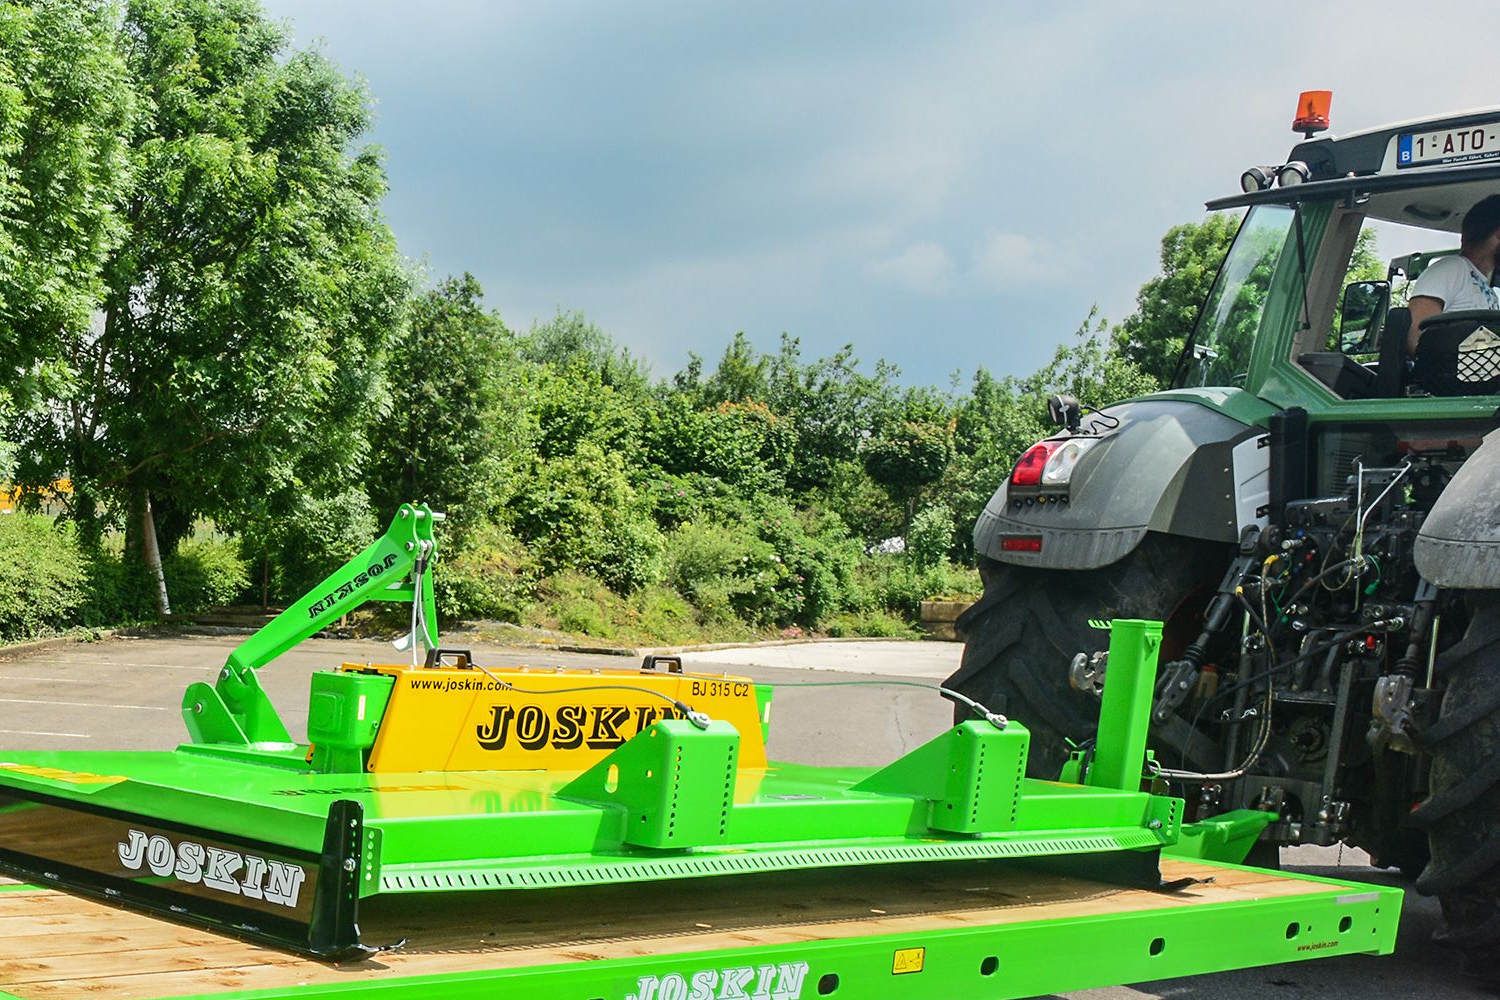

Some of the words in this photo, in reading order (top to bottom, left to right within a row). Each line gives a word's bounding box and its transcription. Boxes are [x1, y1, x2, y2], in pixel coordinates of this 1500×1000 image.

[1402, 151, 1410, 161] B
[308, 553, 398, 618] JOSKIN
[411, 678, 513, 692] www.joskin.com
[692, 682, 708, 696] BJ
[710, 682, 730, 697] 315
[733, 683, 749, 697] C2
[117, 829, 306, 908] JOSKIN
